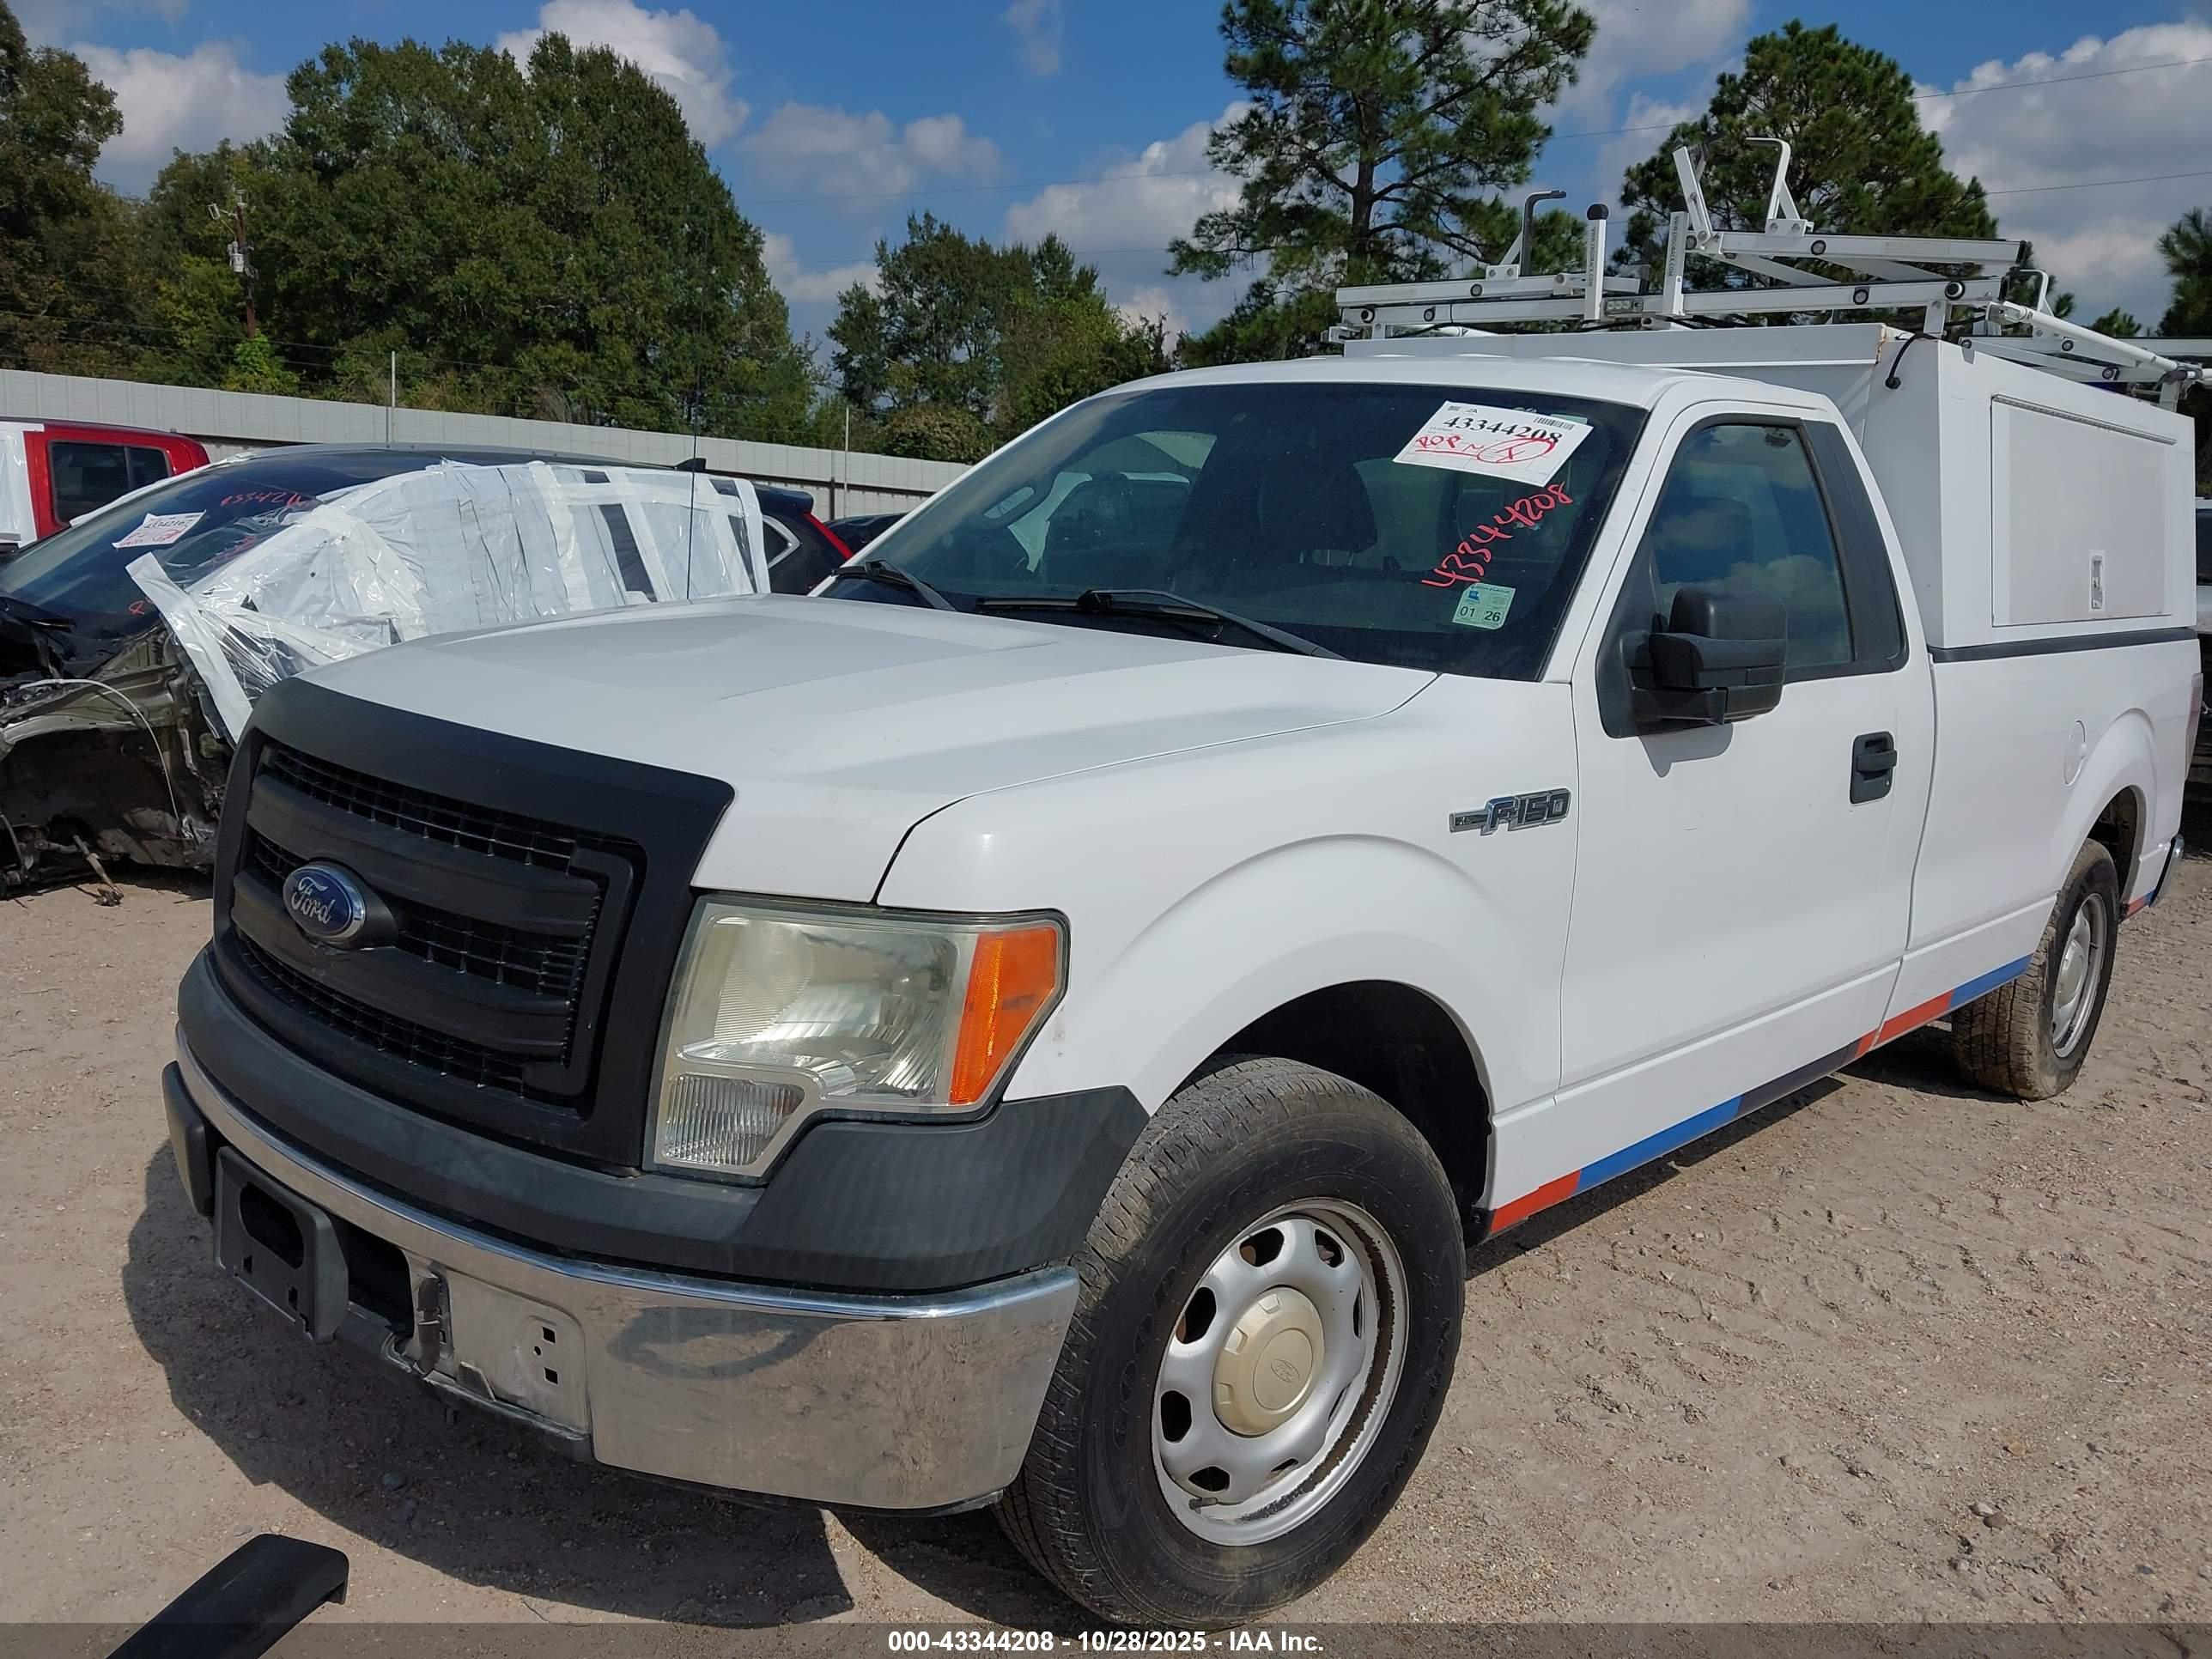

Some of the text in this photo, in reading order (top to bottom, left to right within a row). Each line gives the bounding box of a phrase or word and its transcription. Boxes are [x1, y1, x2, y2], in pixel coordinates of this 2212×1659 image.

[1443, 416, 1563, 444] 43344208
[1421, 481, 1572, 587] 43344208
[1460, 606, 1501, 622] 01 26
[1480, 788, 1571, 836] F-150
[291, 876, 336, 924] Ford
